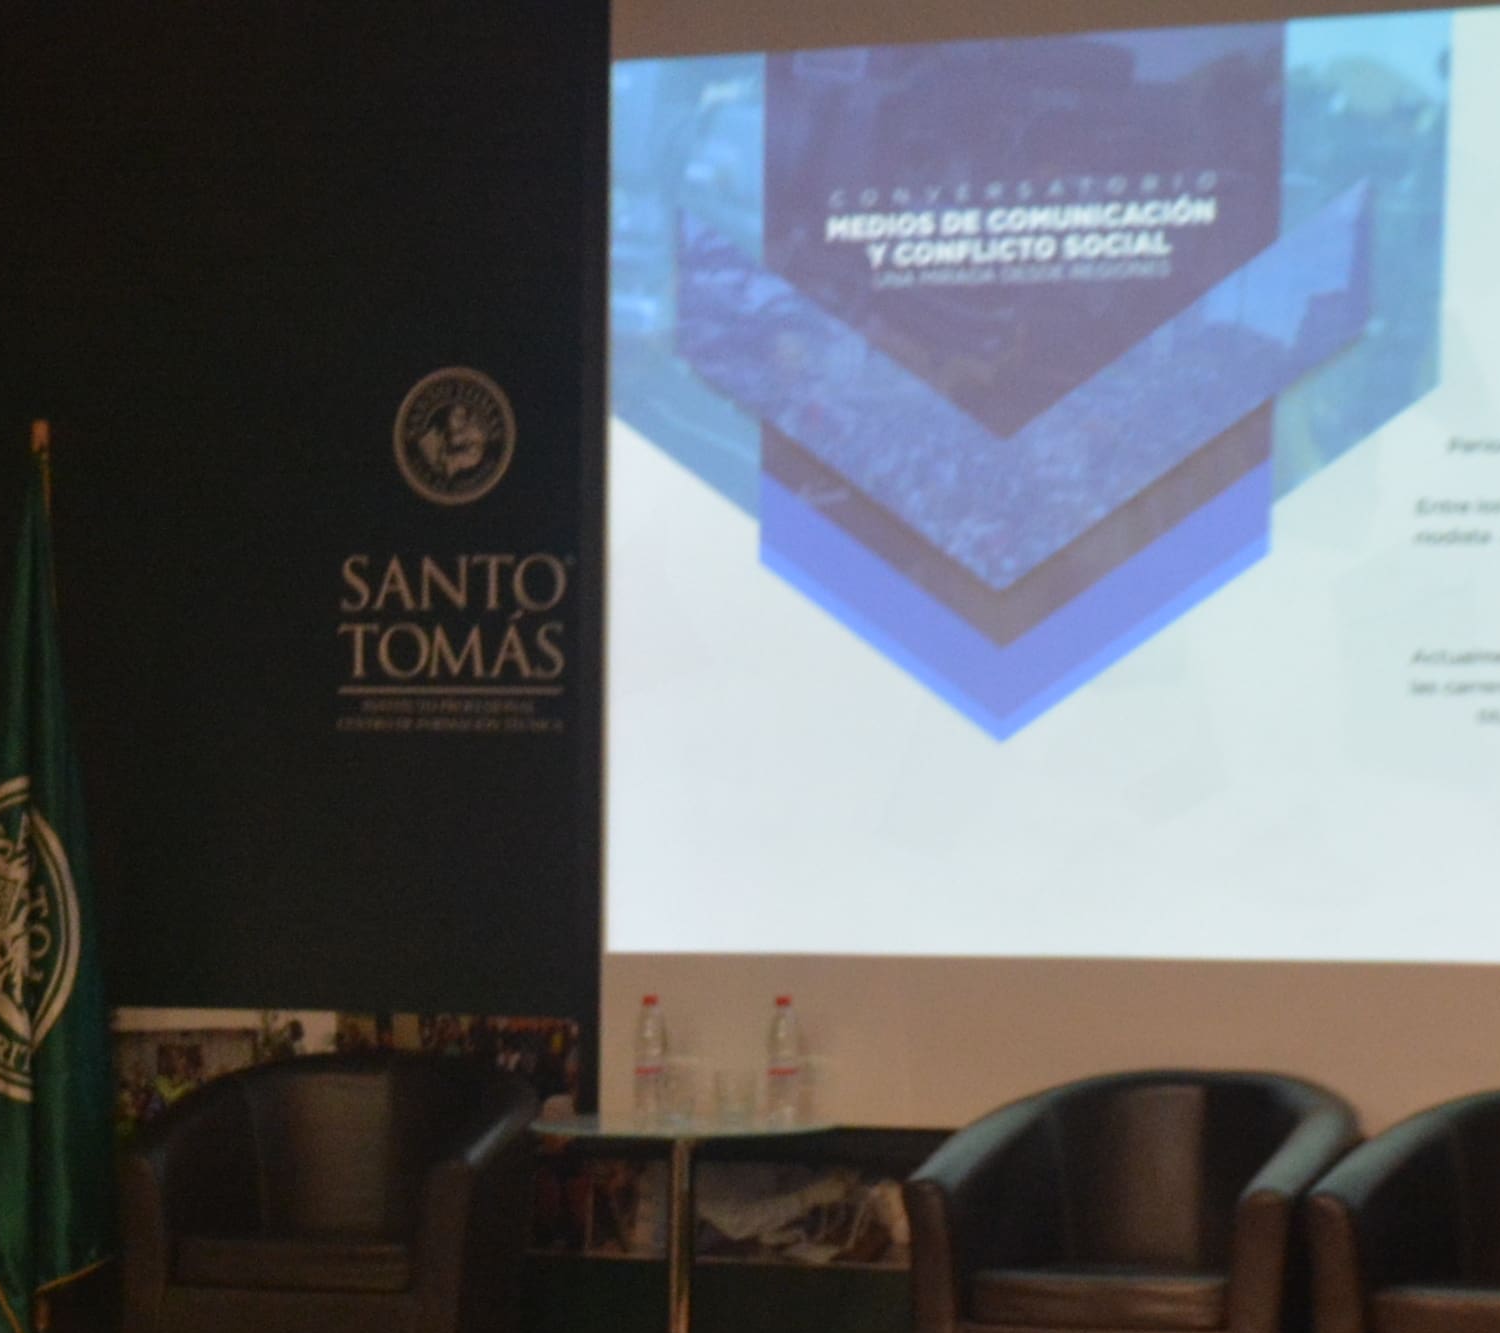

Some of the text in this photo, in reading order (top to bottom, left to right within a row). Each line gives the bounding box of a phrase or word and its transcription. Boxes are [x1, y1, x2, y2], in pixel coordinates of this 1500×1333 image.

[825, 195, 1217, 242] MEDIOS DE COMUNICACIÓN
[867, 230, 1173, 269] Y CONFLICTO SOCIAL
[340, 553, 568, 613] SANTO
[336, 611, 566, 680] TOMÁS
